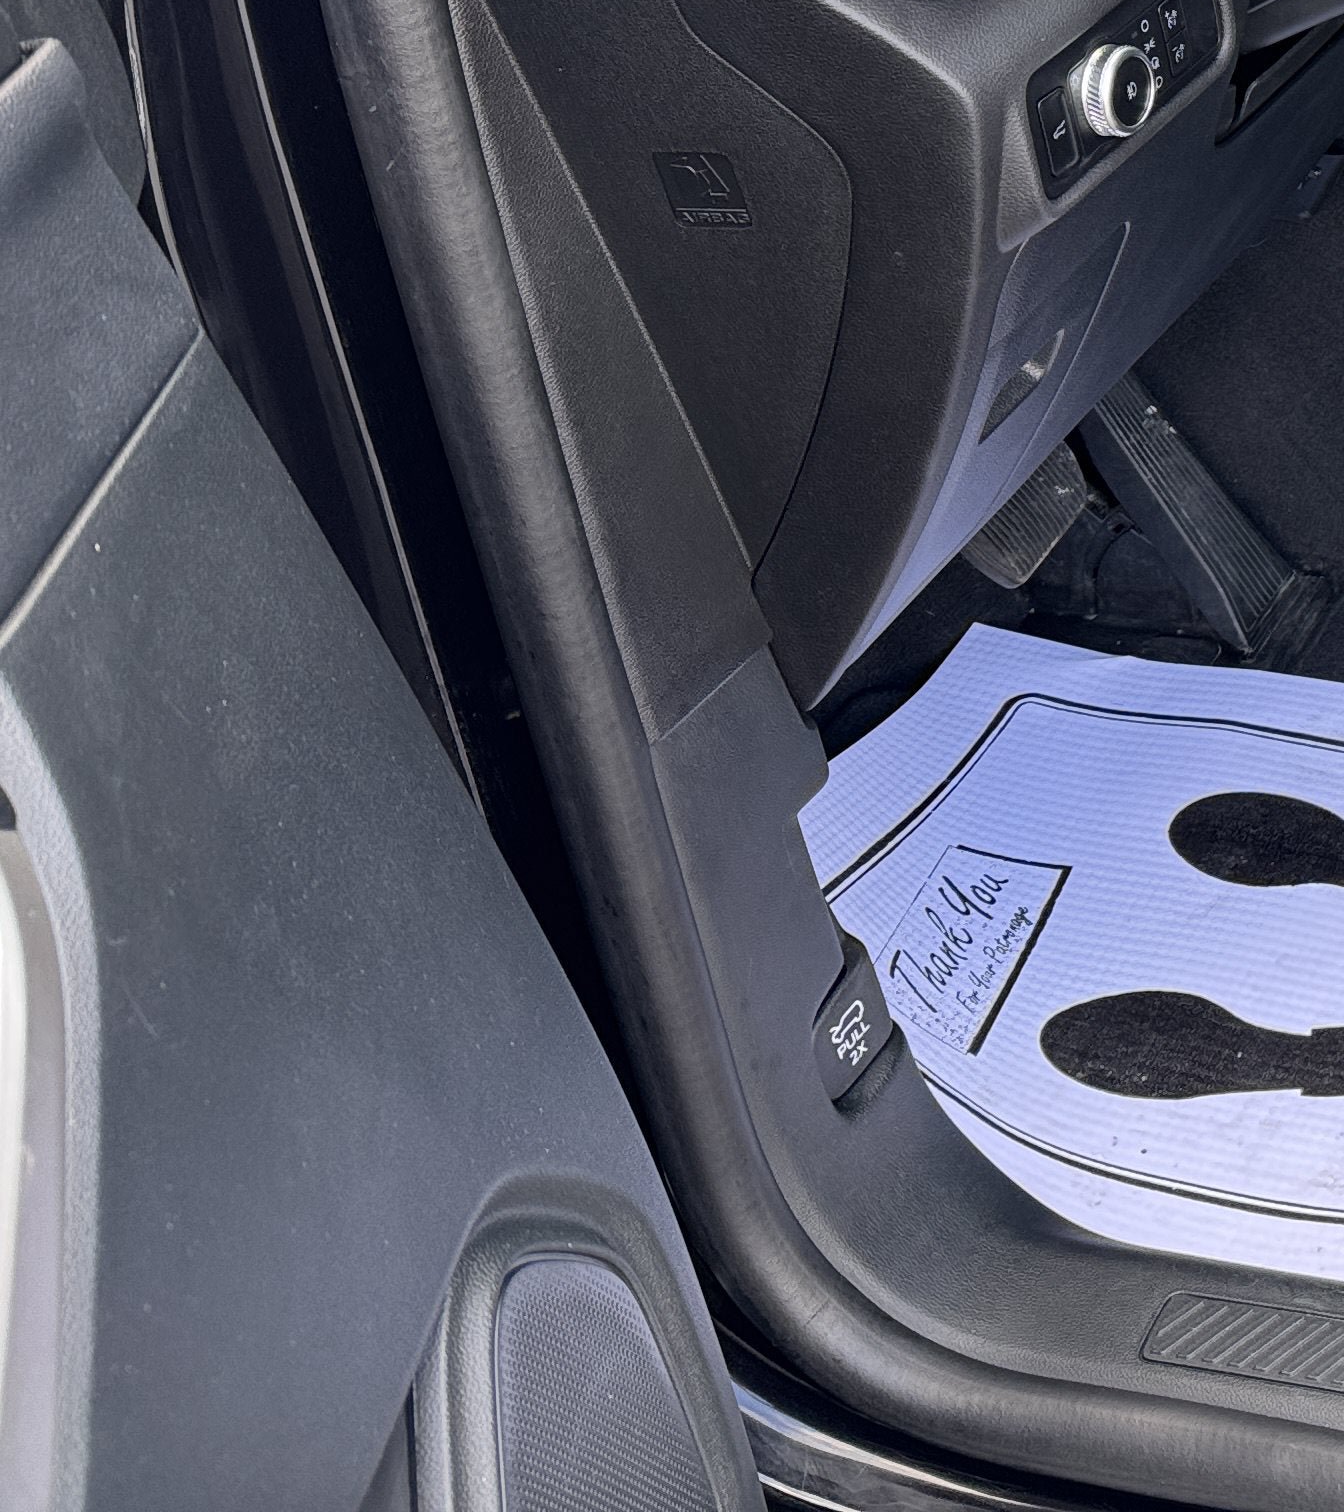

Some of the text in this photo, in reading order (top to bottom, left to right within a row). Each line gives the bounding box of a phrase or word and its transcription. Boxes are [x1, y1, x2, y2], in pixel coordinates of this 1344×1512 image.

[682, 212, 750, 224] AIRBAG
[889, 874, 1010, 1014] Thank You
[955, 906, 1033, 1014] For Your Patronage
[836, 1021, 871, 1060] PULL
[849, 1039, 869, 1066] 2X
